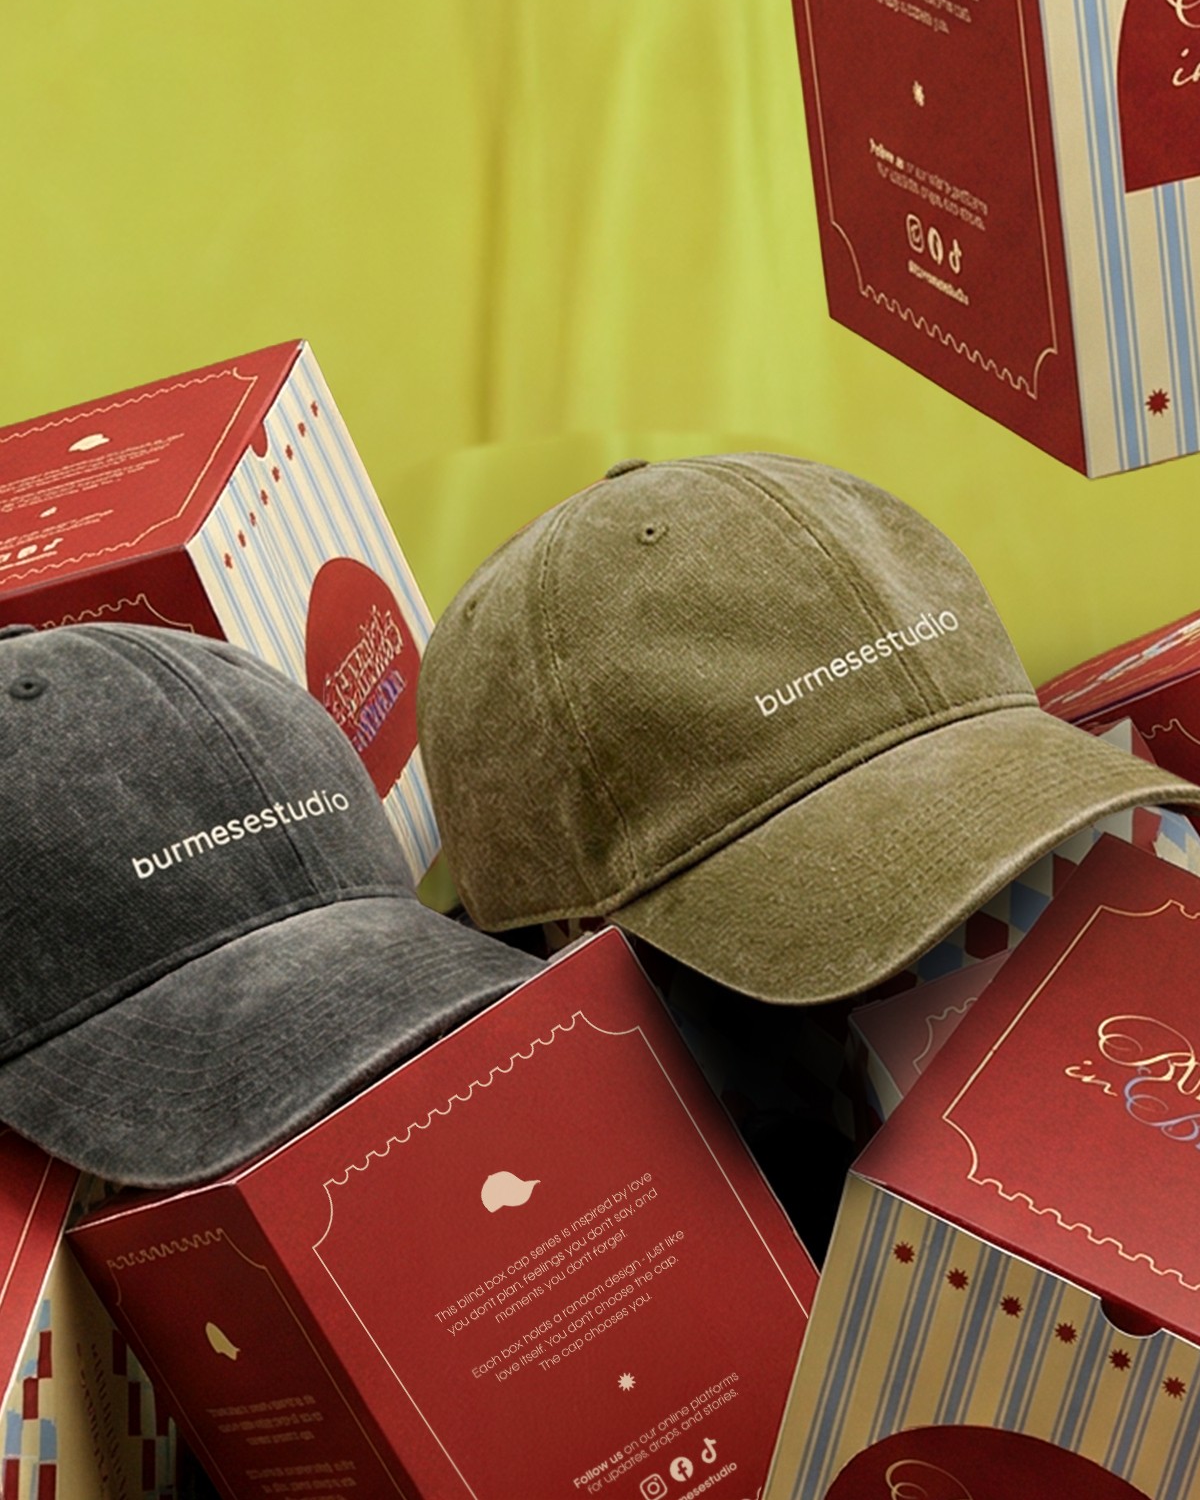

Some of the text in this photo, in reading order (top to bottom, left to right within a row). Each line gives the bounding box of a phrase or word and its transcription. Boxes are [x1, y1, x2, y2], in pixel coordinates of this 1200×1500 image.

[754, 610, 959, 717] burmesestudio
[132, 790, 350, 879] burmesestudio
[1065, 1061, 1117, 1097] in
[435, 1172, 652, 1323] This blind box cap series is inspired by love
[446, 1316, 470, 1337] you
[469, 1297, 498, 1321] don't
[523, 1251, 566, 1285] feelings
[564, 1236, 588, 1257] you
[587, 1217, 614, 1241] don't
[635, 1187, 658, 1208] and
[494, 1286, 545, 1323] moments
[543, 1271, 567, 1291] you
[566, 1251, 593, 1275] don't
[471, 1355, 502, 1379] Each
[500, 1340, 524, 1358] box
[522, 1319, 553, 1344] holds
[553, 1313, 563, 1323] a
[562, 1284, 605, 1318] random
[604, 1260, 641, 1288] design
[645, 1242, 665, 1263] just
[664, 1230, 684, 1248] like
[495, 1362, 520, 1382] love
[544, 1330, 568, 1347] You
[567, 1310, 595, 1333] don't
[594, 1284, 635, 1315] choose
[633, 1271, 654, 1288] the
[538, 1354, 561, 1371] The
[561, 1338, 584, 1357] cap
[628, 1292, 653, 1312] you.
[573, 1372, 739, 1489] Follow us on our online platforms
[587, 1479, 604, 1495] for
[681, 1411, 704, 1431] and
